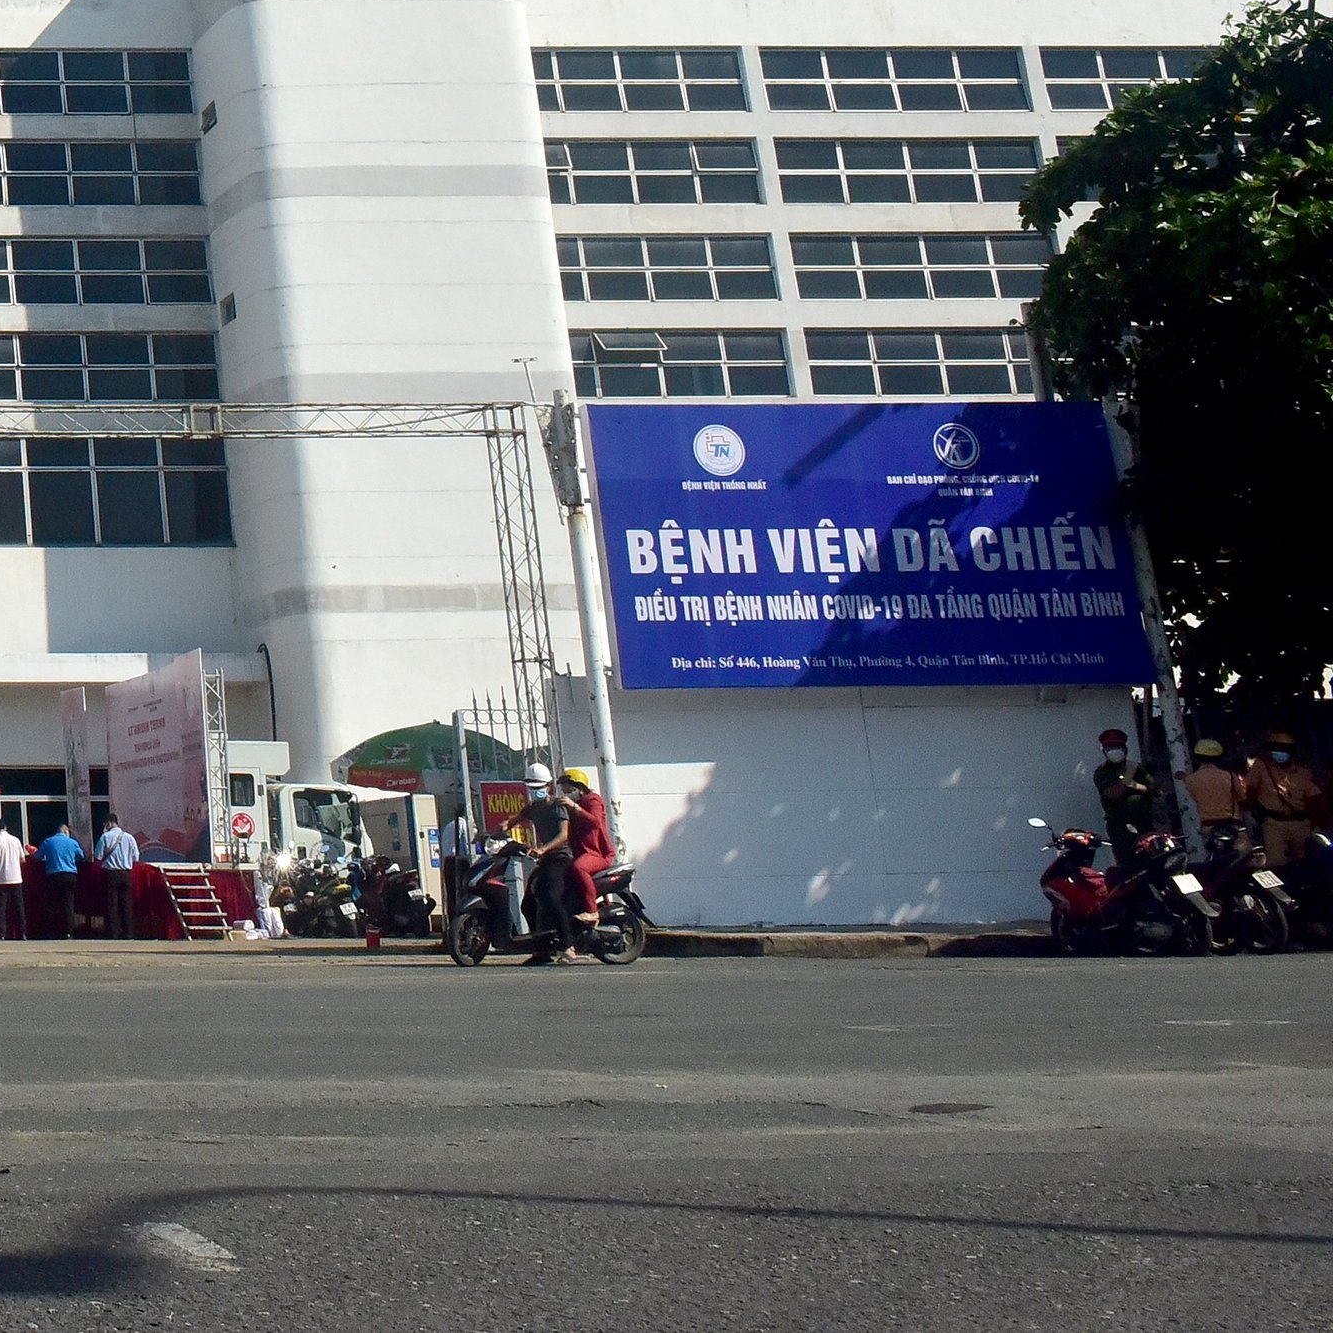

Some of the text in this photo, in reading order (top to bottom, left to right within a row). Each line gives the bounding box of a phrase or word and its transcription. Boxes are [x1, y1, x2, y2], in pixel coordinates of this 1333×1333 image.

[682, 480, 702, 492] BỆNH
[703, 480, 721, 492] VIỆN
[625, 512, 1116, 585] BỆNH VIỆN DÃ CHIẾN
[634, 586, 1125, 627] ĐIỀU TRỊ BỆNH NHÂN COVID-19 ĐA TẦNG QUẬN TÂN BÌNH
[671, 656, 692, 671] Địa
[719, 655, 735, 668] Số
[736, 656, 761, 670] 446,
[762, 656, 801, 670] Hoàng
